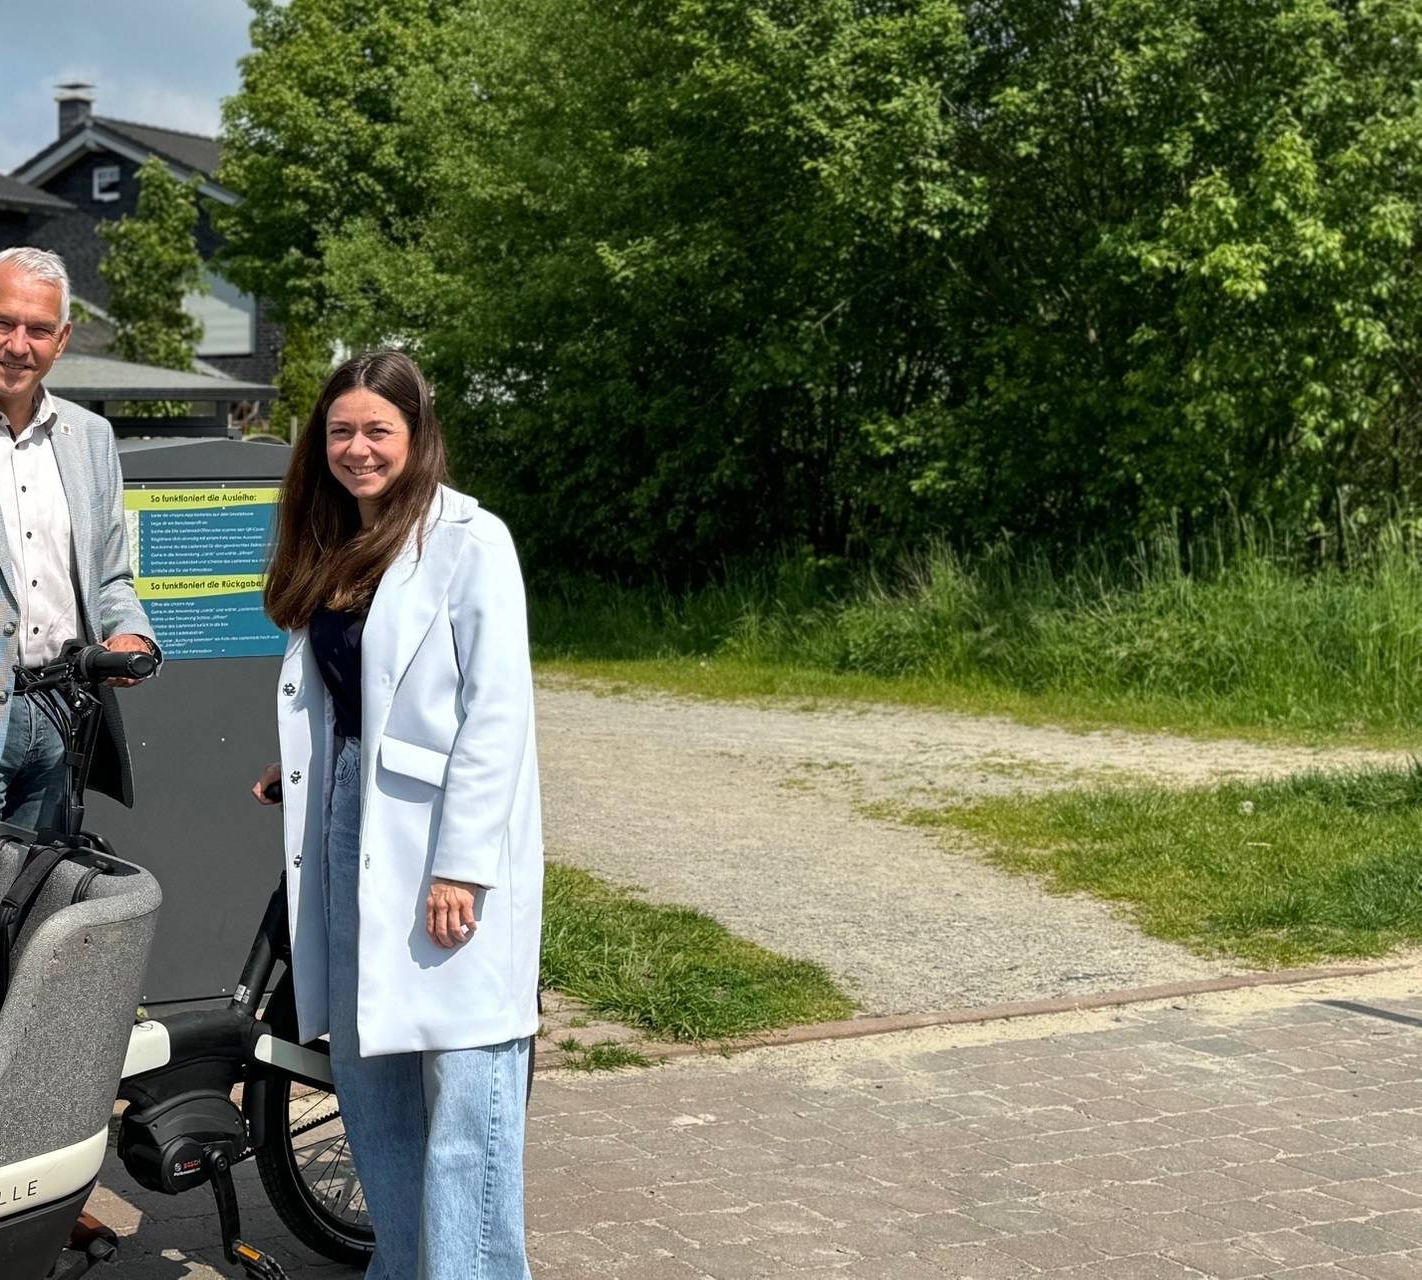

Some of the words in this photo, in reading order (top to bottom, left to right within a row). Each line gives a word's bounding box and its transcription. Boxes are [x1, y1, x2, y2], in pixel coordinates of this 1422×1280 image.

[150, 495, 160, 503] So
[162, 494, 205, 503] funktioniert
[207, 494, 219, 502] die
[222, 493, 257, 502] Ausleihe:
[150, 582, 160, 590] So
[162, 581, 205, 590] funktioniert
[207, 581, 219, 589] die
